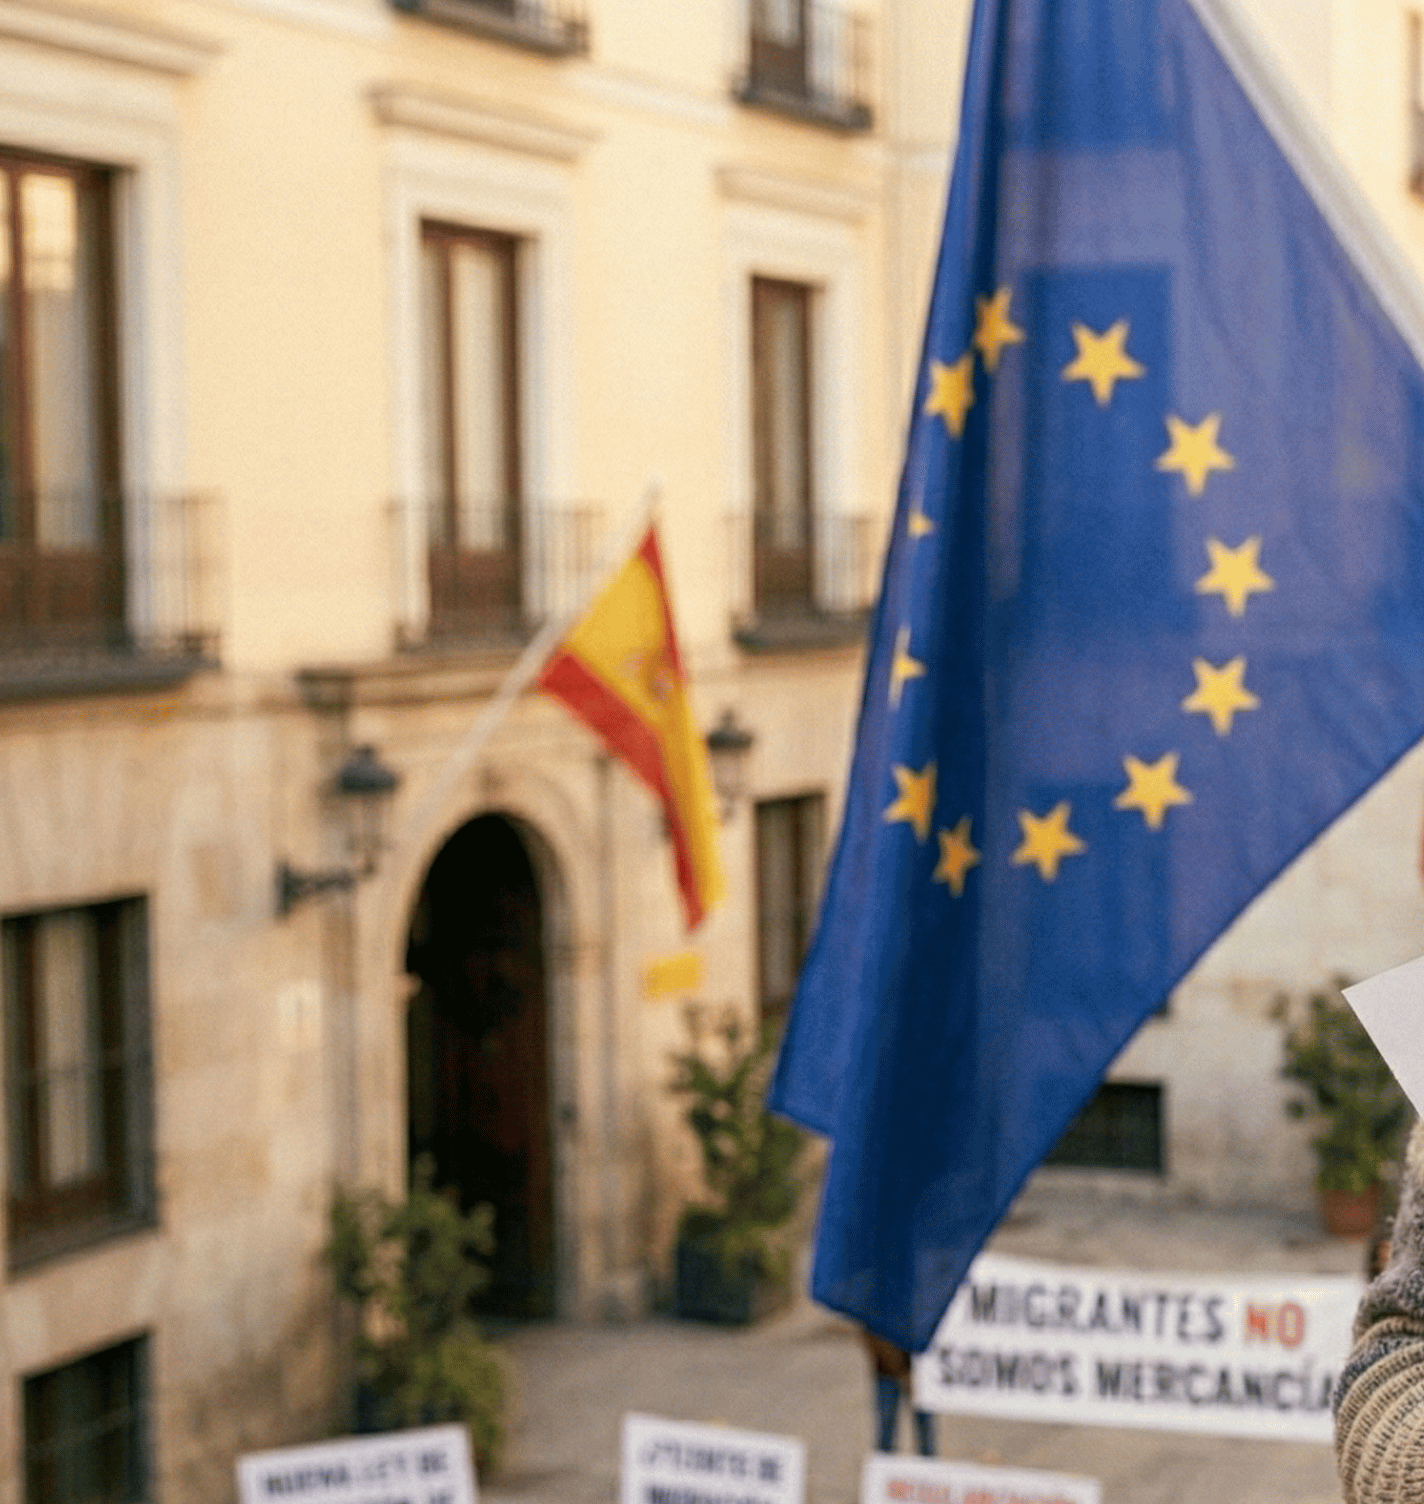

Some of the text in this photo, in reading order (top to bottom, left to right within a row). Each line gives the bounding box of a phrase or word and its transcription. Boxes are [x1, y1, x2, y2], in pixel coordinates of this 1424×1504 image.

[969, 1281, 1306, 1349] MIGRANTES NO
[937, 1349, 1079, 1397] SOMOS
